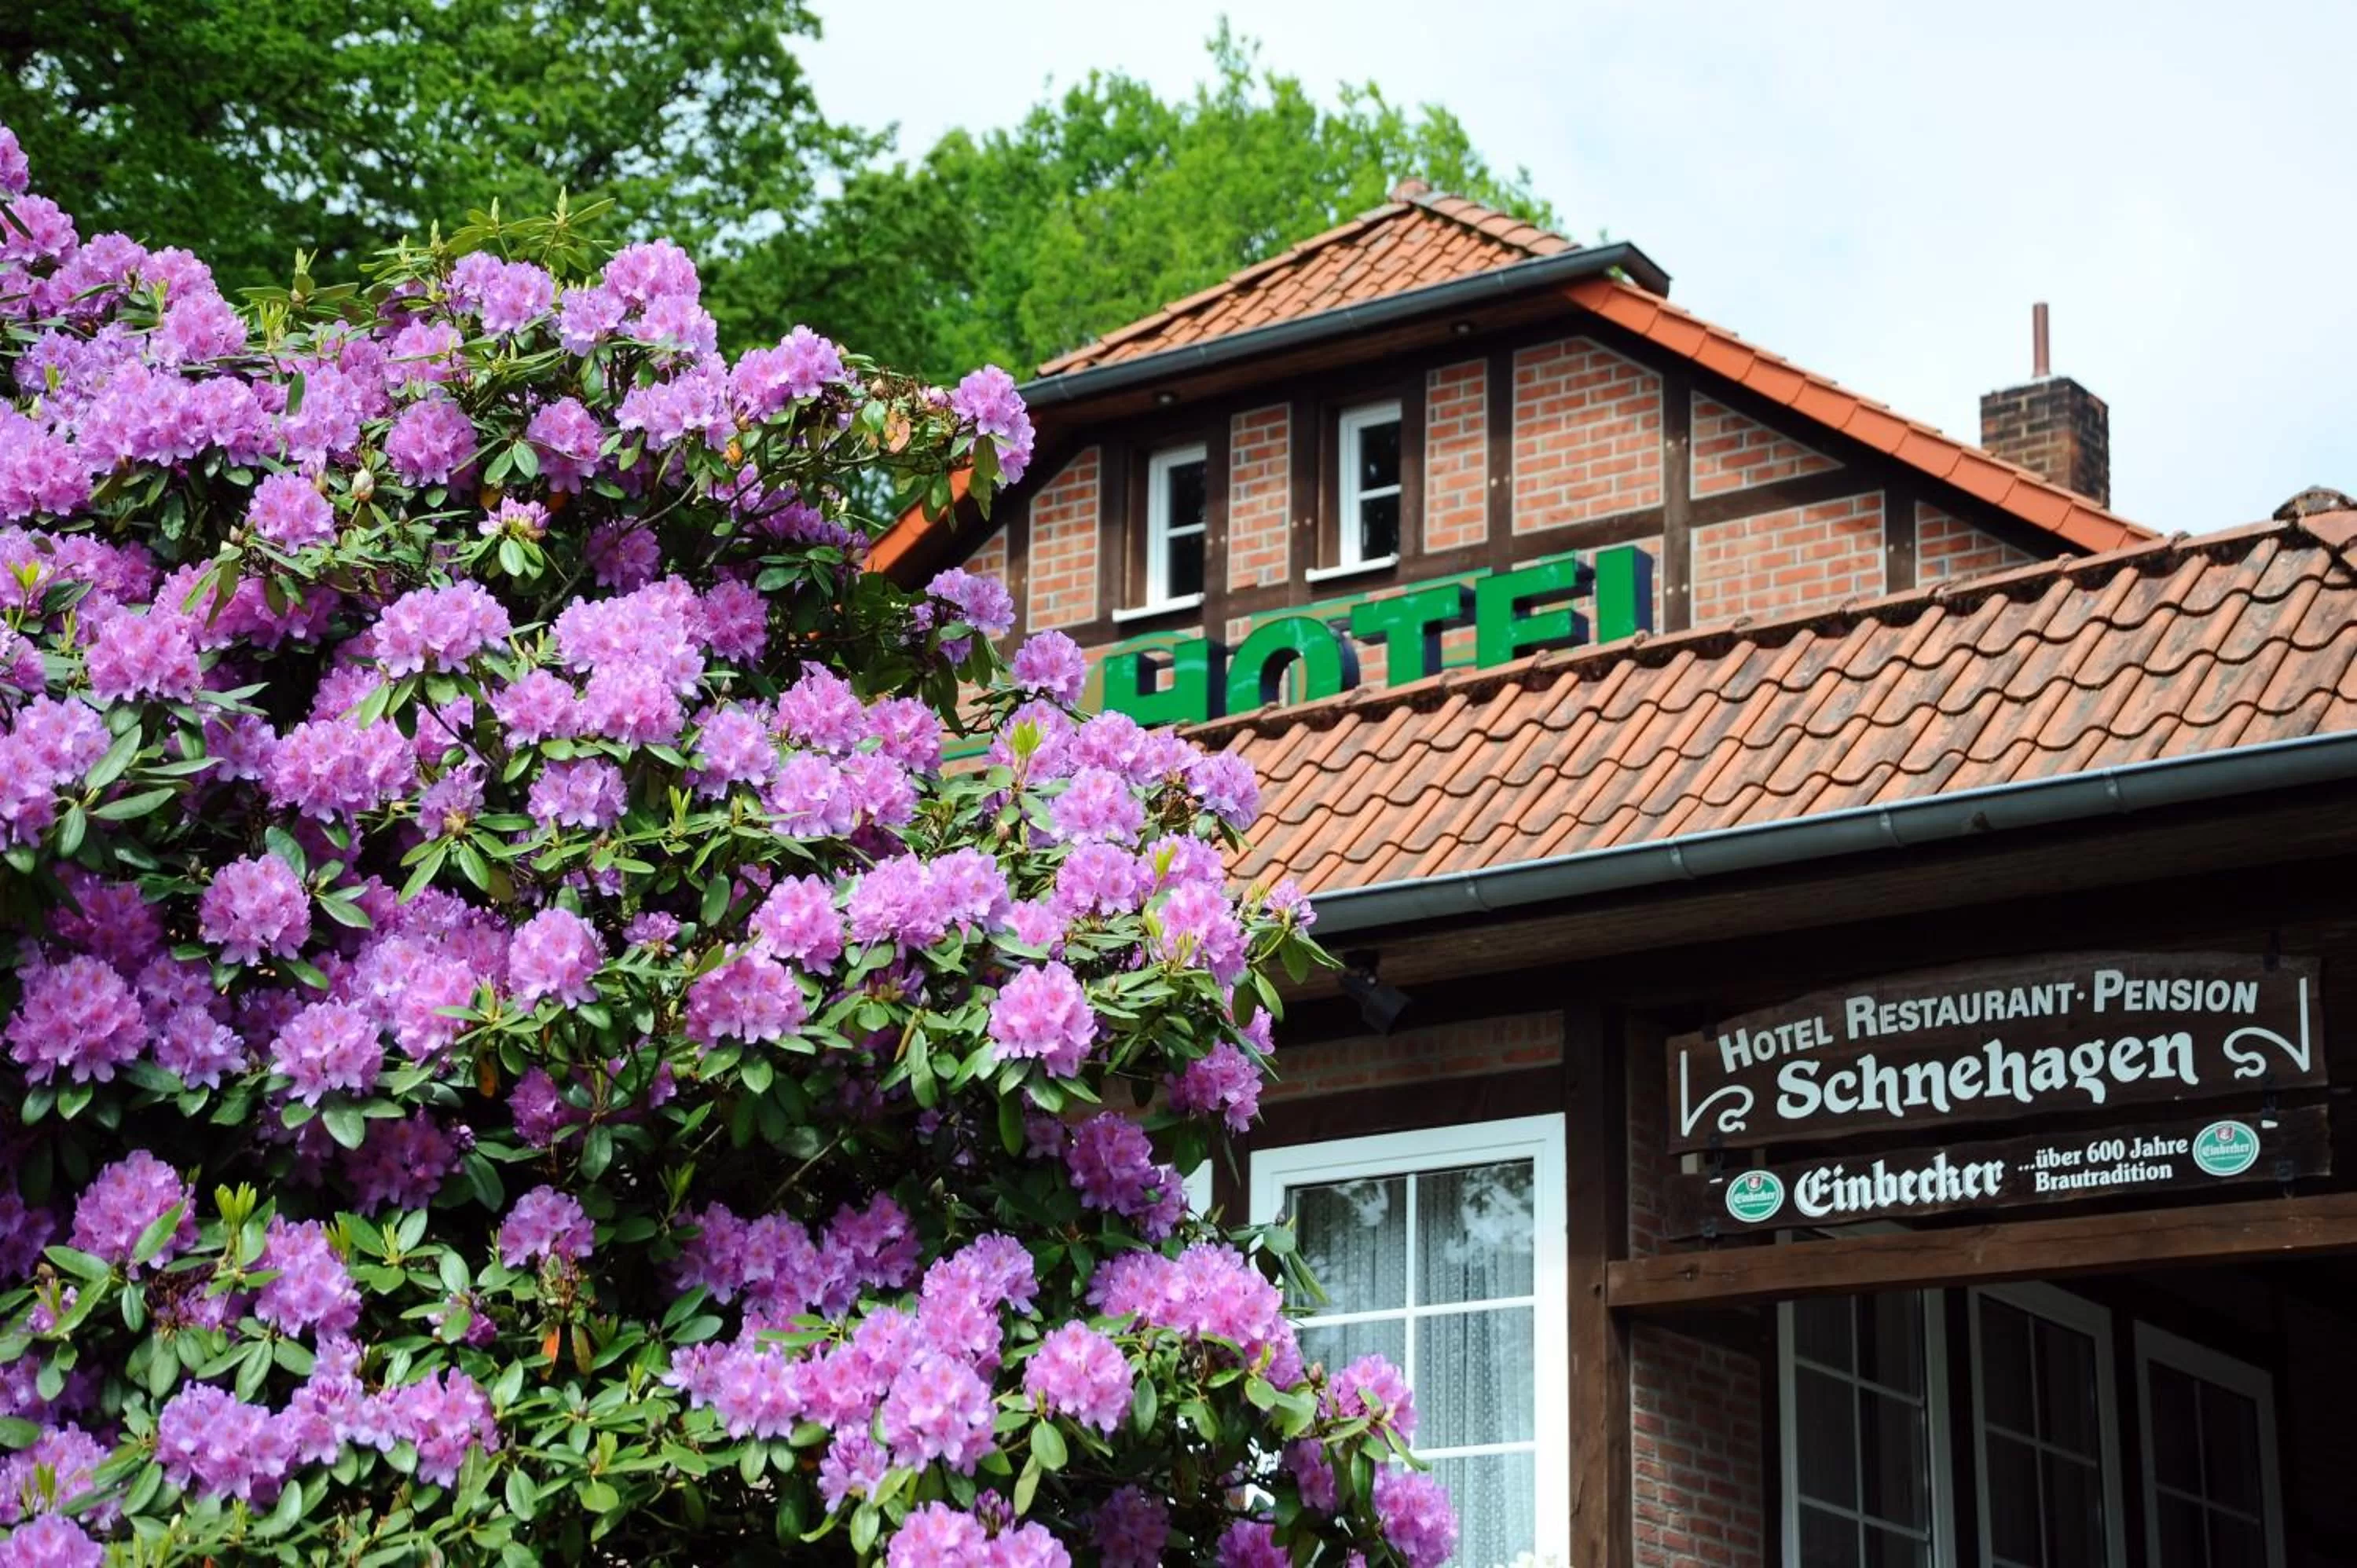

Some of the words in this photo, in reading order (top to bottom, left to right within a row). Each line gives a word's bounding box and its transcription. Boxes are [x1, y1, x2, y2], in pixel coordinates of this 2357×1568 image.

[1719, 1017, 1834, 1073] HOTEL
[2094, 969, 2258, 1013] PENSION
[1776, 1032, 2199, 1119] Schnehagen
[2035, 1163, 2173, 1192] Brautradition
[2087, 1139, 2125, 1163] 600
[2130, 1136, 2188, 1159] Jahre
[1794, 1152, 2005, 1218] Einbecker
